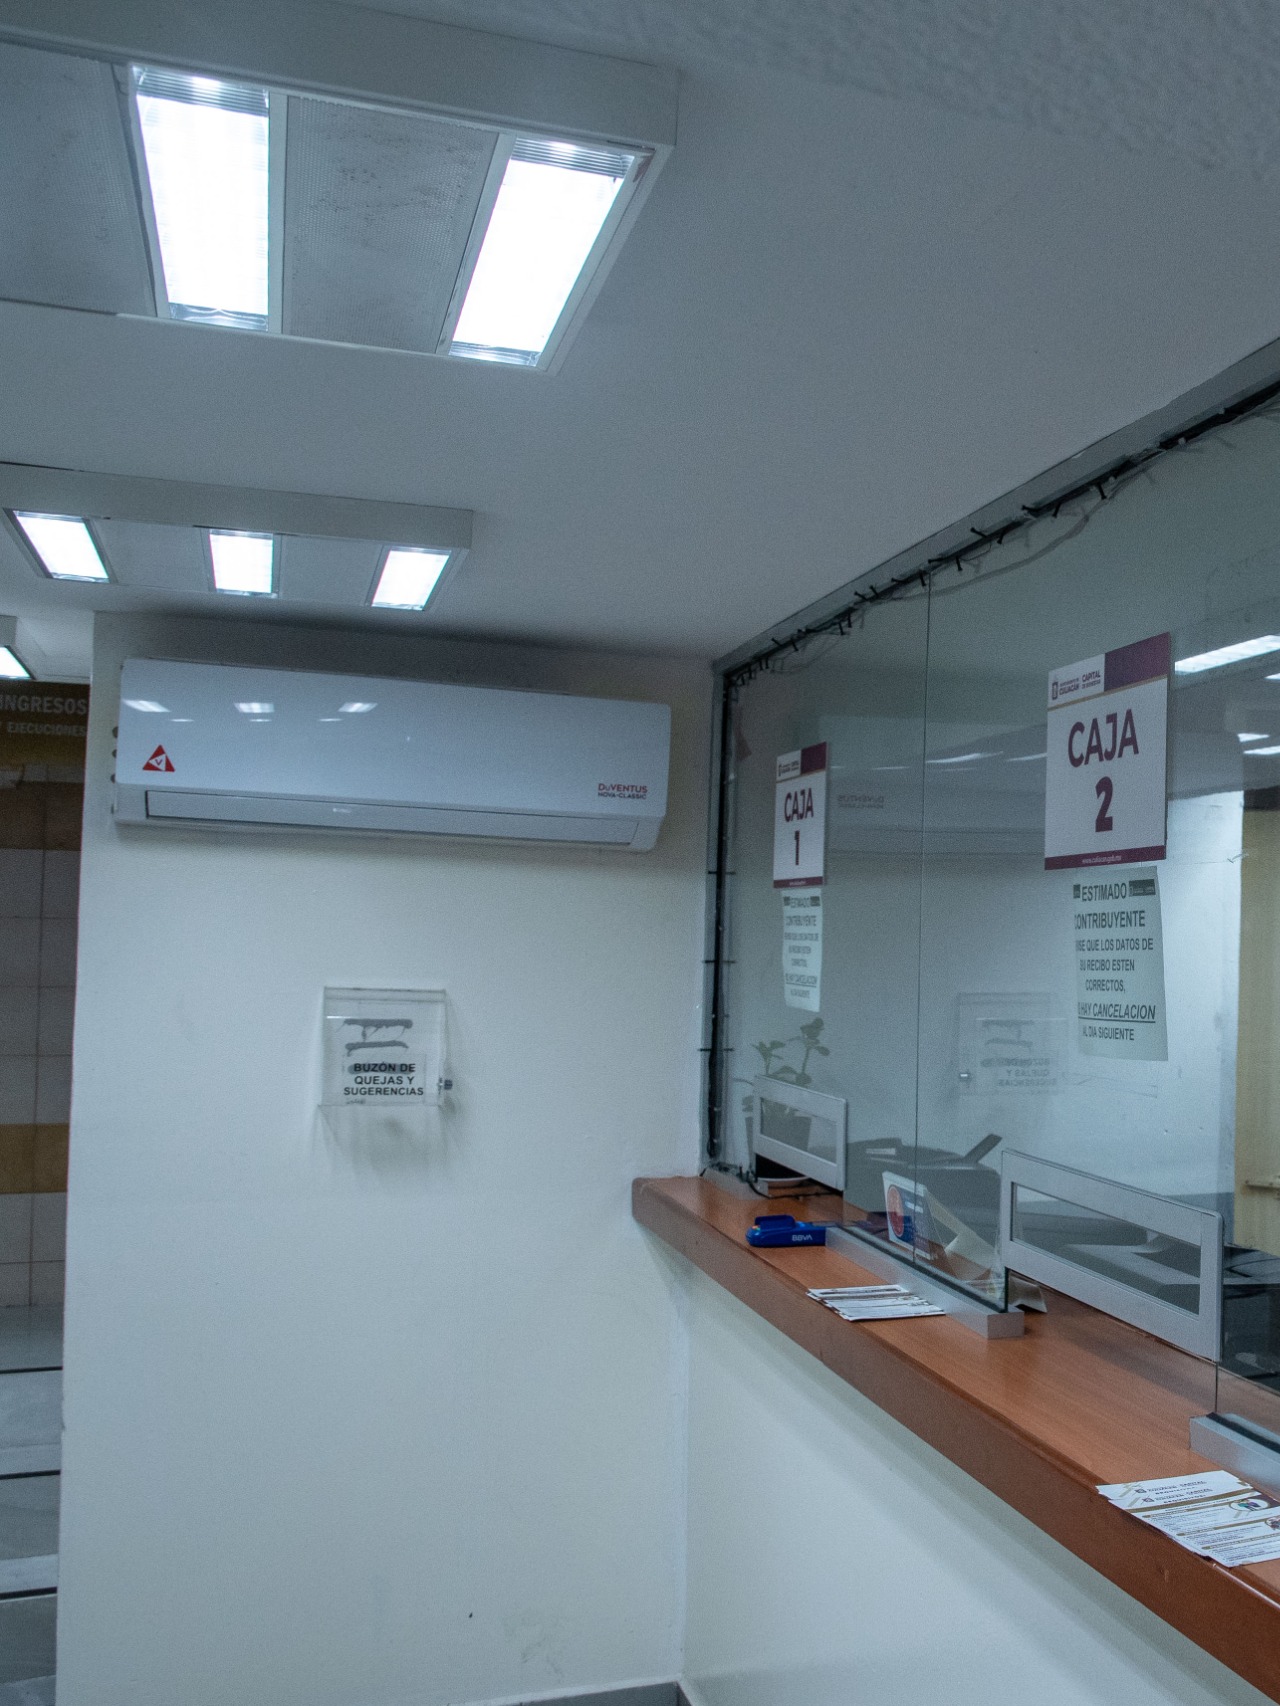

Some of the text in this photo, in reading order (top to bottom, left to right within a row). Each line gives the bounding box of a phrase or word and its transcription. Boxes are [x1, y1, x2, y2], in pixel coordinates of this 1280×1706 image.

[0, 694, 87, 715] INGRESOS
[1068, 709, 1139, 768] CAJA
[784, 788, 814, 822] CAJA
[1095, 776, 1113, 833] 2
[794, 830, 800, 866] 1
[1082, 882, 1127, 902] ESTIMADO
[1087, 939, 1099, 952] QUE
[1101, 939, 1114, 951] LOS
[1116, 938, 1140, 951] DATOS
[1142, 938, 1154, 951] DE
[1087, 959, 1110, 971] RECIBO
[1112, 960, 1135, 971] ESTEN
[1085, 979, 1126, 994] CORRECTOS,
[1093, 1003, 1156, 1020] CANCELACION
[1099, 1027, 1135, 1041] SIGUIENTE
[353, 1061, 416, 1072] BUZÓN DE
[354, 1076, 414, 1085] QUEJAS Y
[344, 1087, 424, 1096] SUGERENCIAS
[792, 1234, 813, 1242] BBVA
